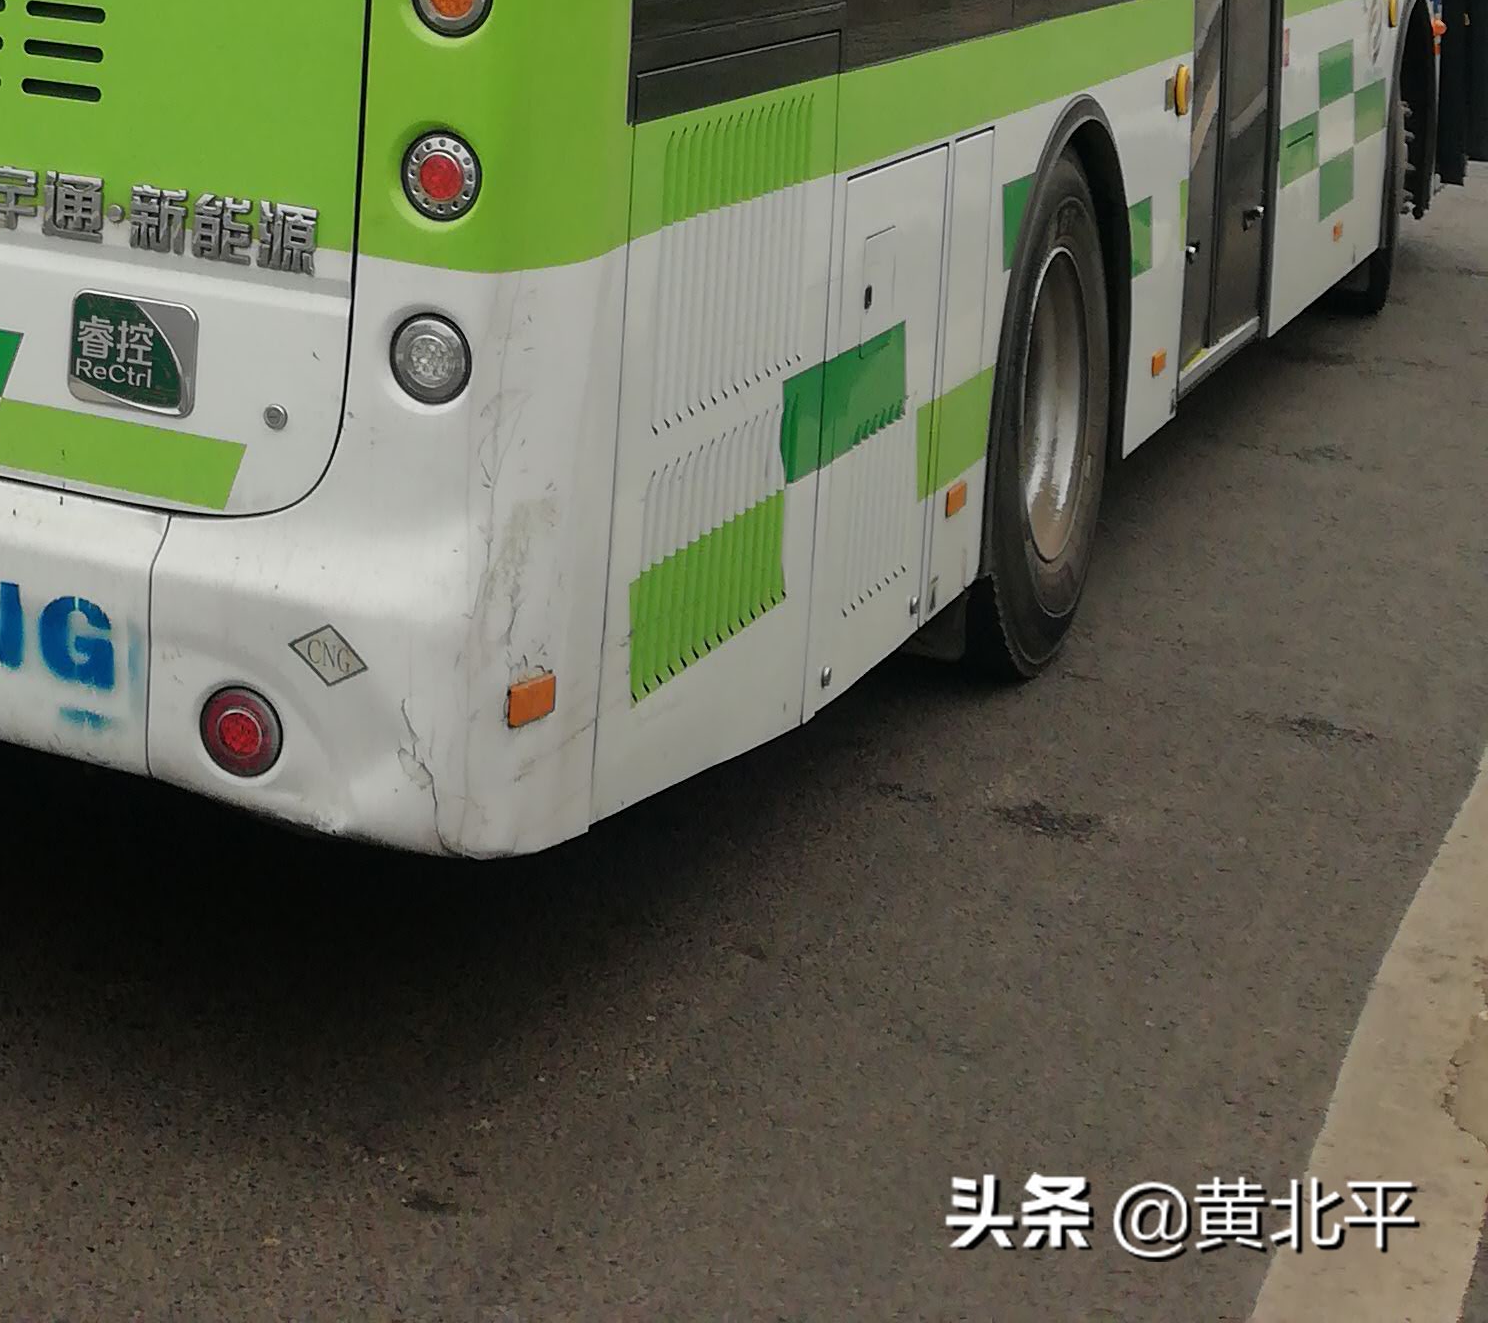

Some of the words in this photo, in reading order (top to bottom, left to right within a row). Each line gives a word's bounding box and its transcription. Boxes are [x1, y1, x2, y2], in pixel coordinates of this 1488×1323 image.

[78, 316, 154, 367] 睿控
[76, 358, 152, 388] ReCtrl
[308, 639, 353, 673] CNG
